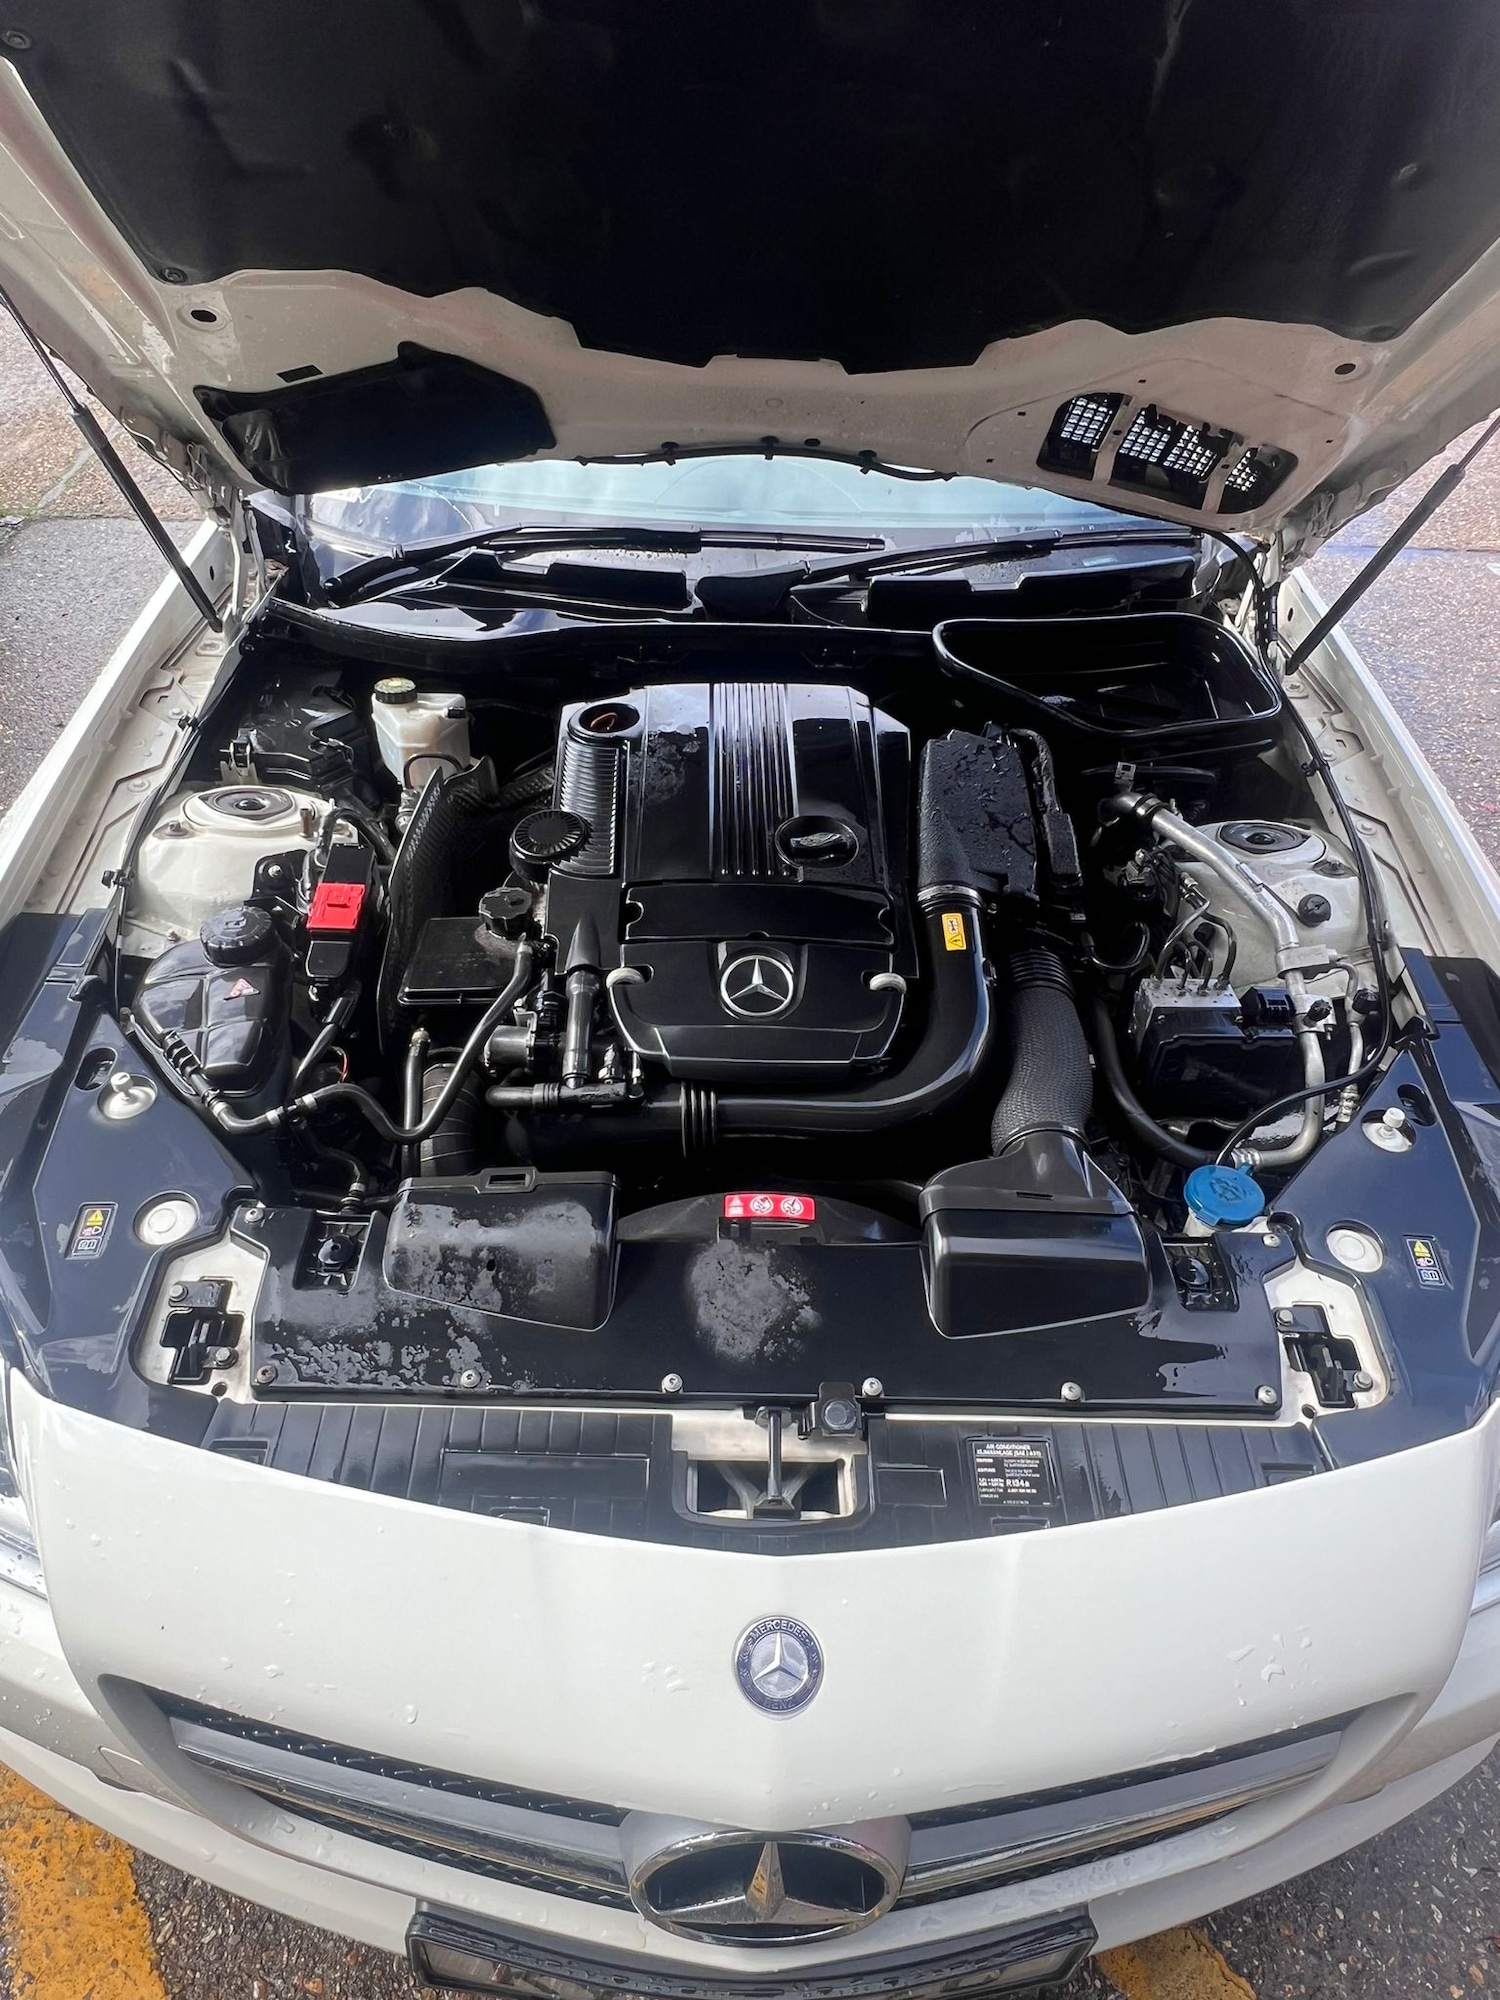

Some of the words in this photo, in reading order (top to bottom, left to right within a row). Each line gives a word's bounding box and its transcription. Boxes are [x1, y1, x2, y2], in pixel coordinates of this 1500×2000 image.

[1006, 1478, 1030, 1488] R134a
[750, 1619, 810, 1641] MERCEDES
[763, 1697, 795, 1710] BENZ
